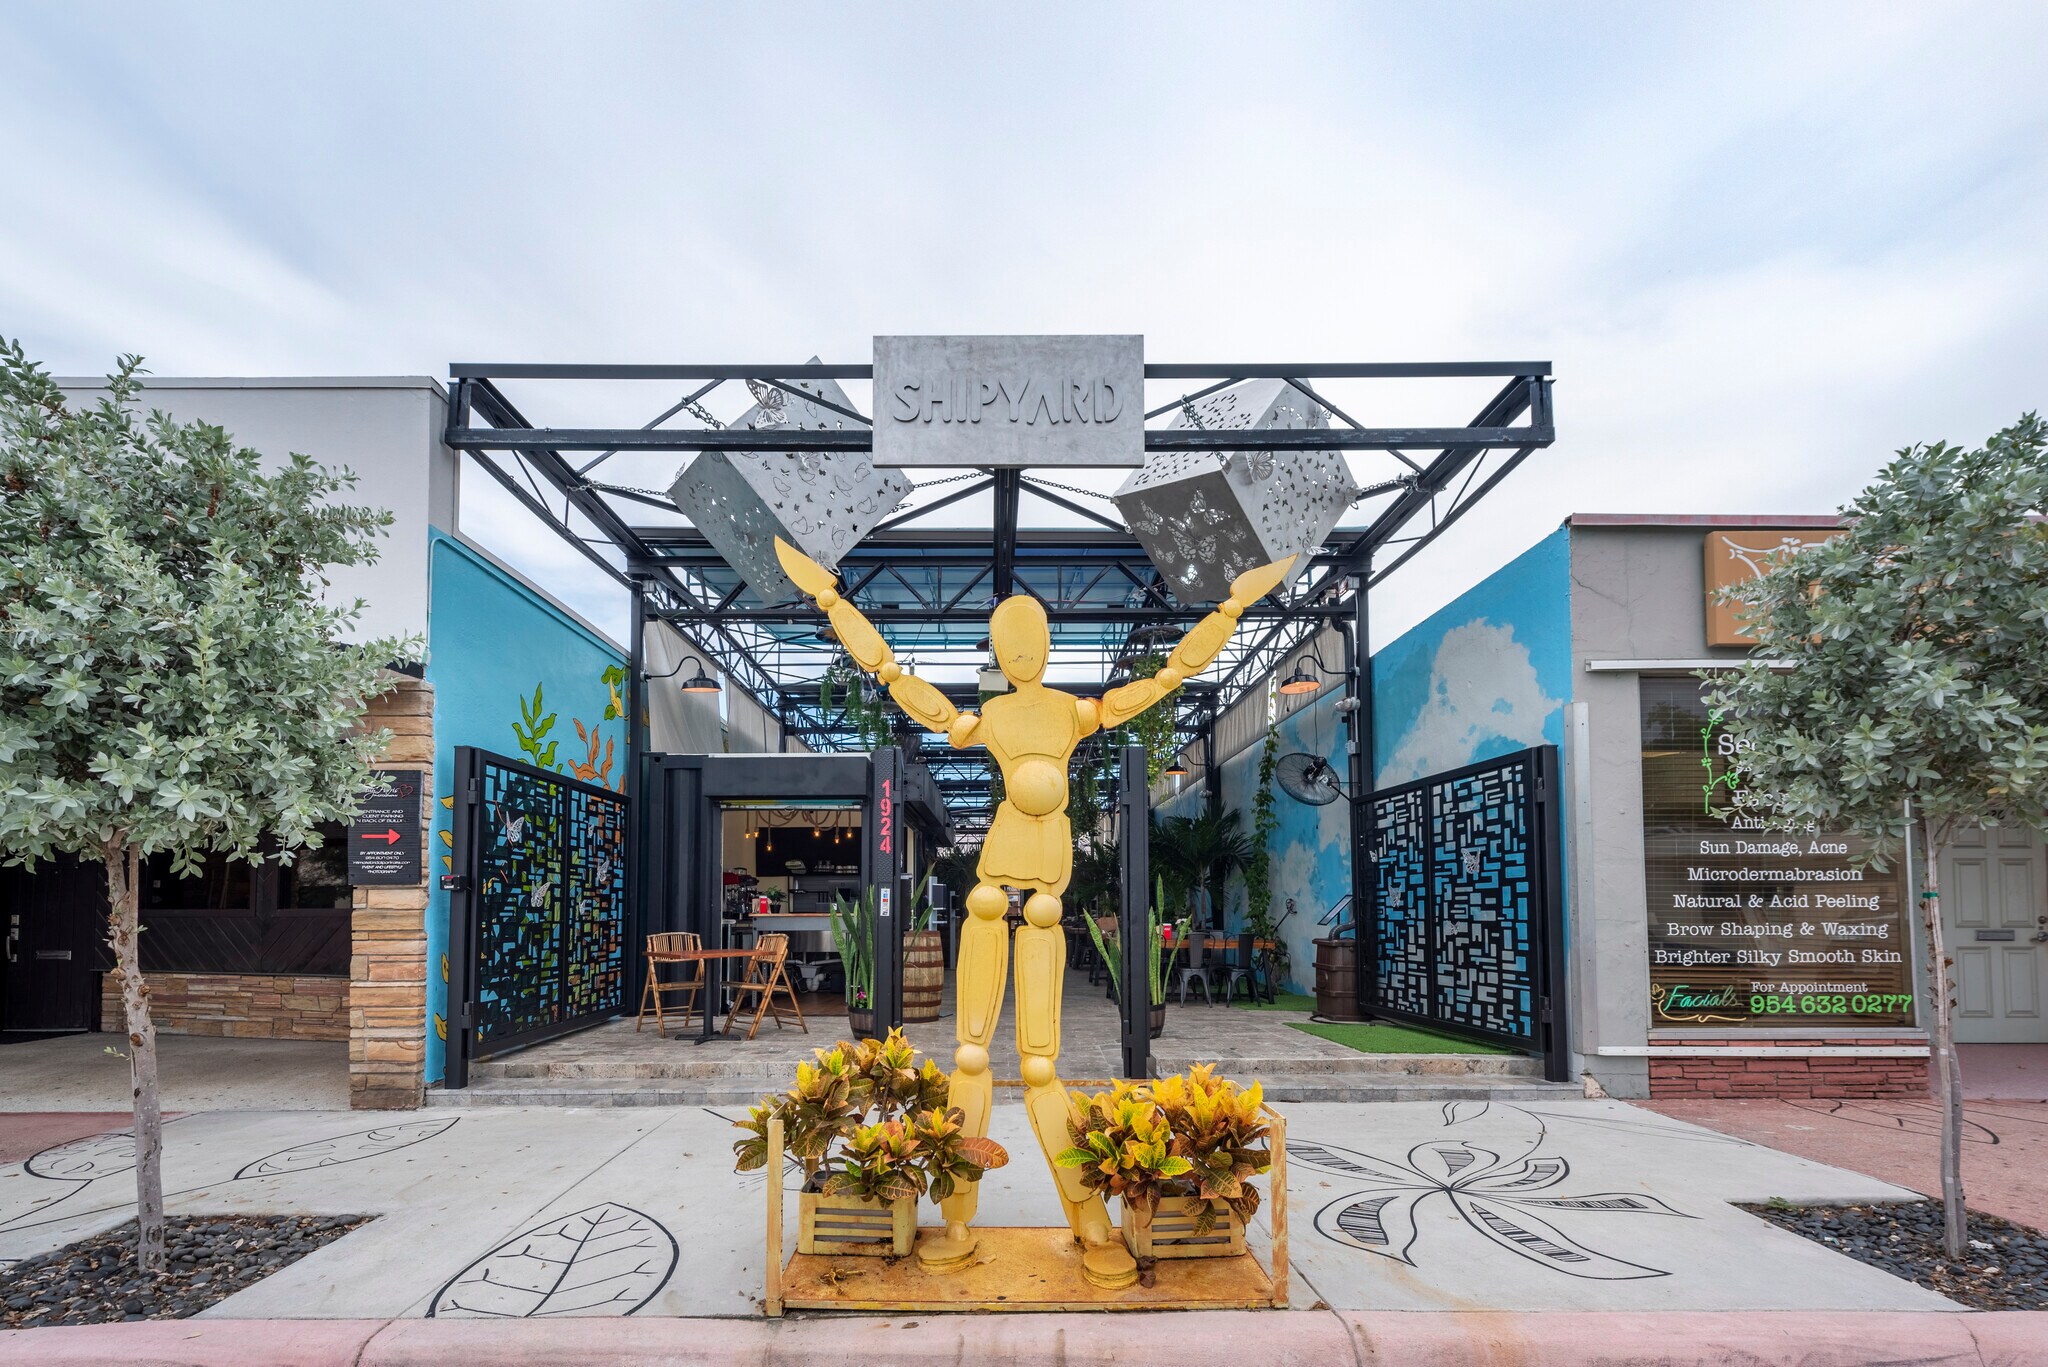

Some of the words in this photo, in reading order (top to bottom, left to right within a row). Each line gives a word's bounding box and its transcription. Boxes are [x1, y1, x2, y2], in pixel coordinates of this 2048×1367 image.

[892, 374, 1126, 426] SHIPYARD
[879, 779, 892, 855] 1924
[1700, 840, 1731, 855] Sun
[1735, 840, 1803, 857] Damage,
[1808, 840, 1848, 854] Acne
[1687, 867, 1864, 881] Microdermabrasion
[1673, 894, 1742, 908] Natural
[1748, 894, 1764, 908] &
[1769, 894, 1809, 908] Acid
[1815, 894, 1880, 911] Peeling
[1666, 922, 1714, 936] Brow
[1720, 922, 1794, 939] Shaping
[1799, 921, 1815, 936] &
[1821, 922, 1889, 939] Waxing
[1654, 949, 1731, 966] Brighter
[1736, 949, 1783, 966] Silky
[1788, 949, 1856, 963] Smooth
[1861, 949, 1903, 963] Skin
[1751, 981, 1775, 993] For
[1778, 981, 1868, 995] Appointment
[1663, 984, 1745, 1012] Facials
[1750, 994, 1796, 1014] 954
[1800, 994, 1847, 1014] 632
[1851, 993, 1913, 1014] 0277
